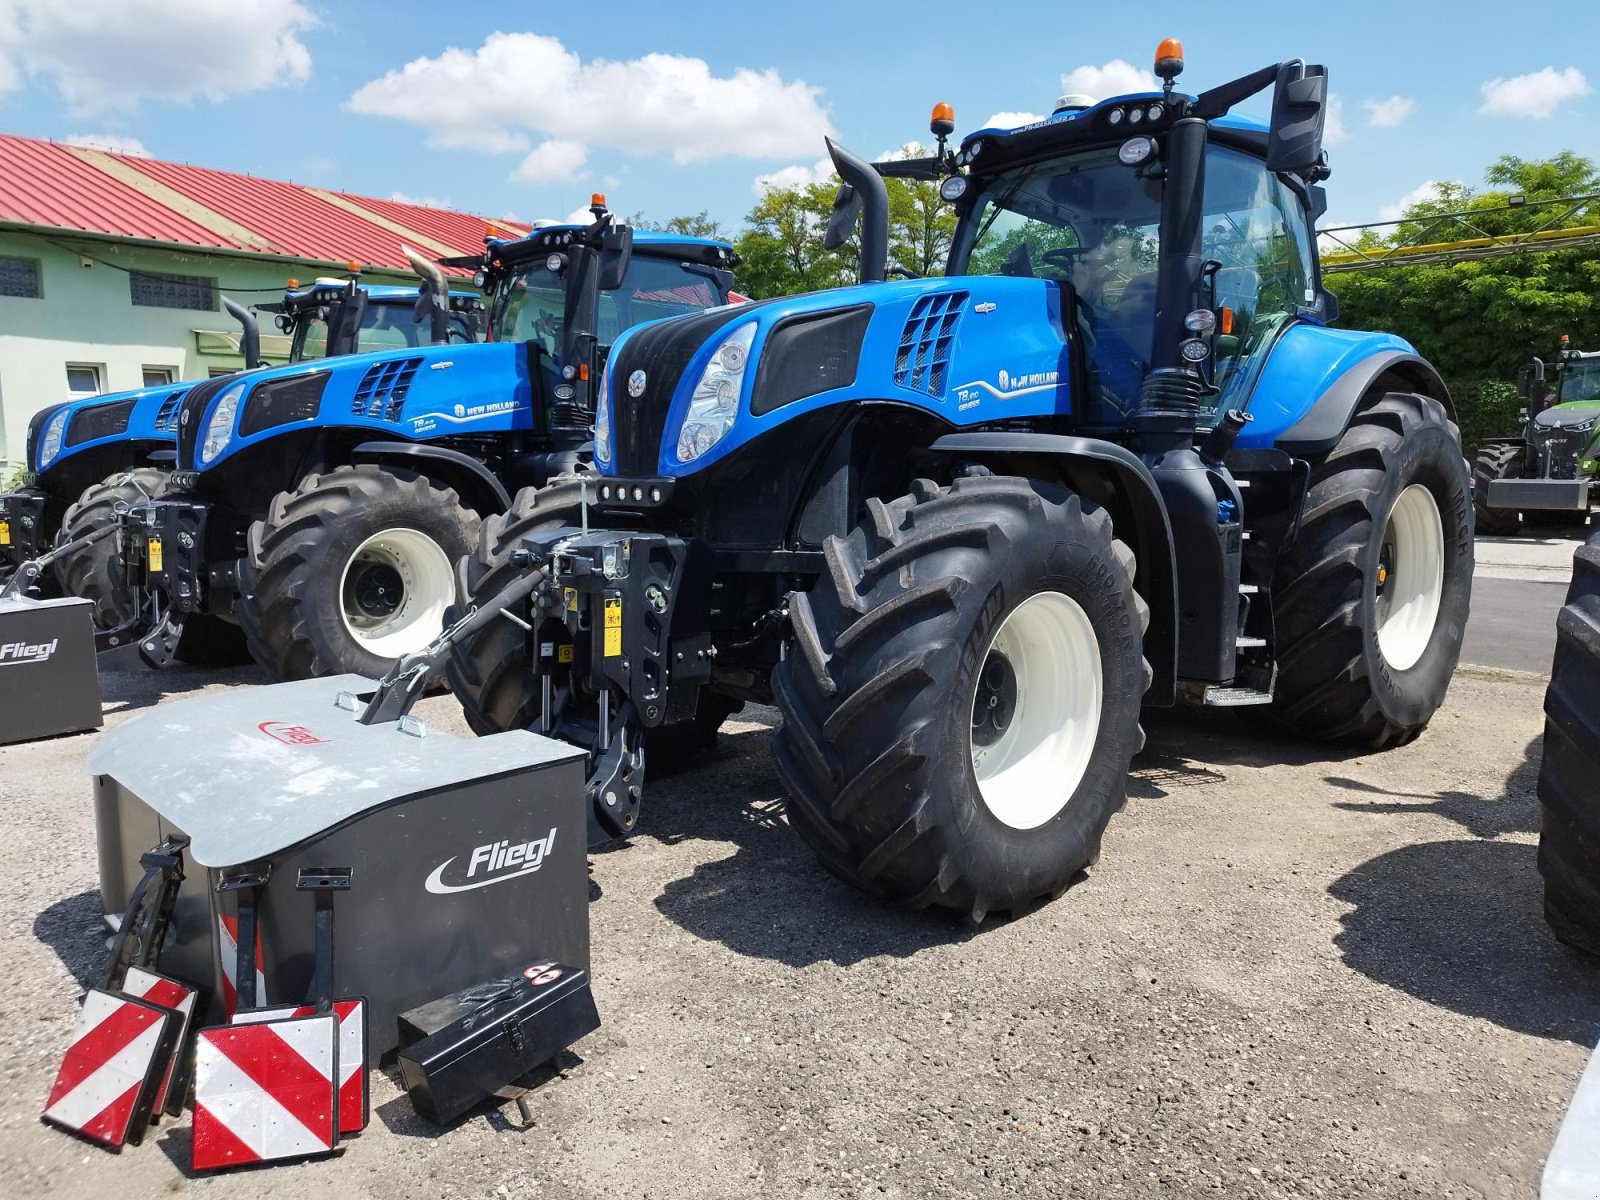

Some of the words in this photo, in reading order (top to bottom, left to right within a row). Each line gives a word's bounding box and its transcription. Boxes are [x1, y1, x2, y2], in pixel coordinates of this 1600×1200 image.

[467, 405, 485, 415] NEW
[486, 400, 520, 413] HOLLAND
[0, 638, 59, 660] Fliegl
[466, 827, 557, 878] Fliegl
